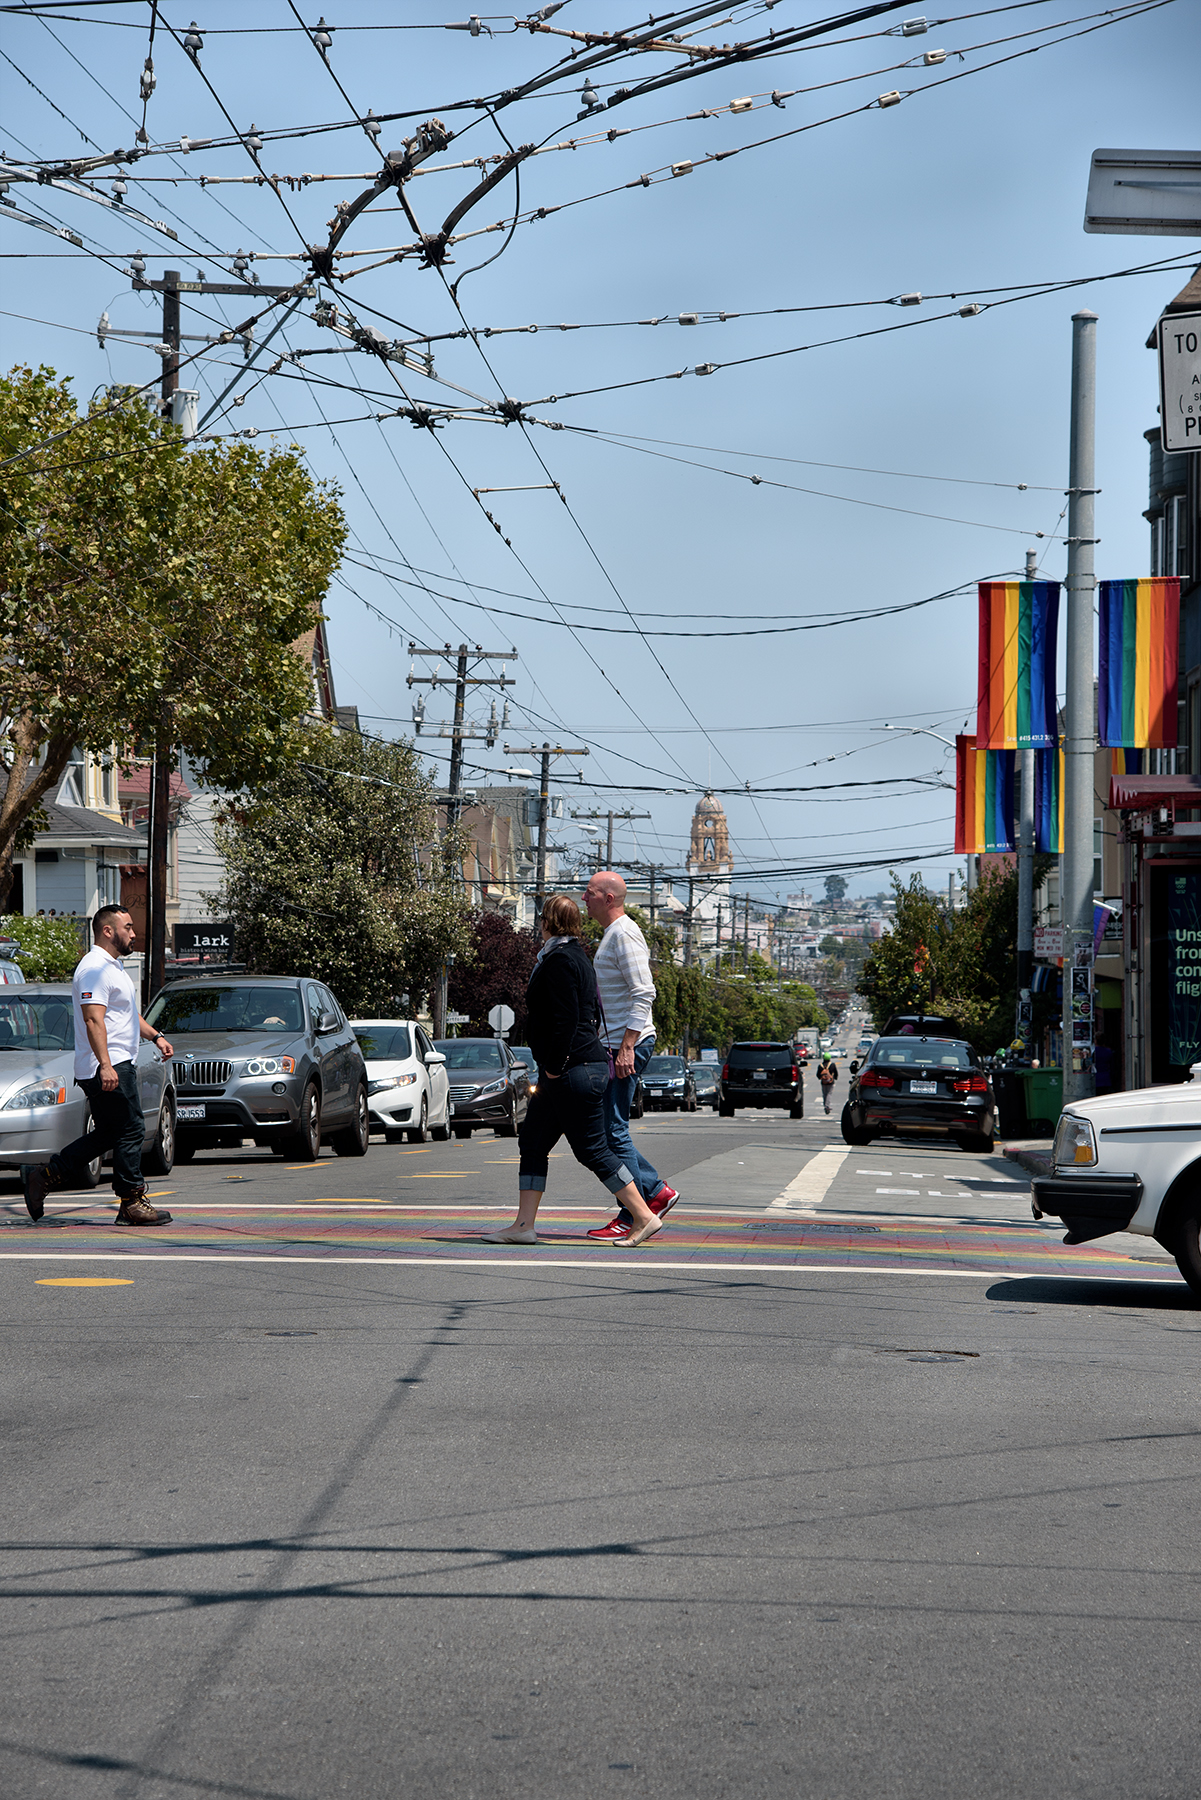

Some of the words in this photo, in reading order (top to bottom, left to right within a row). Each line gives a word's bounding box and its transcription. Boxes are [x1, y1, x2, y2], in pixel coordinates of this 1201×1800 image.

[193, 934, 230, 947] lark
[1175, 945, 1201, 959] fro
[1175, 981, 1201, 997] flig
[1179, 1041, 1200, 1049] FLY
